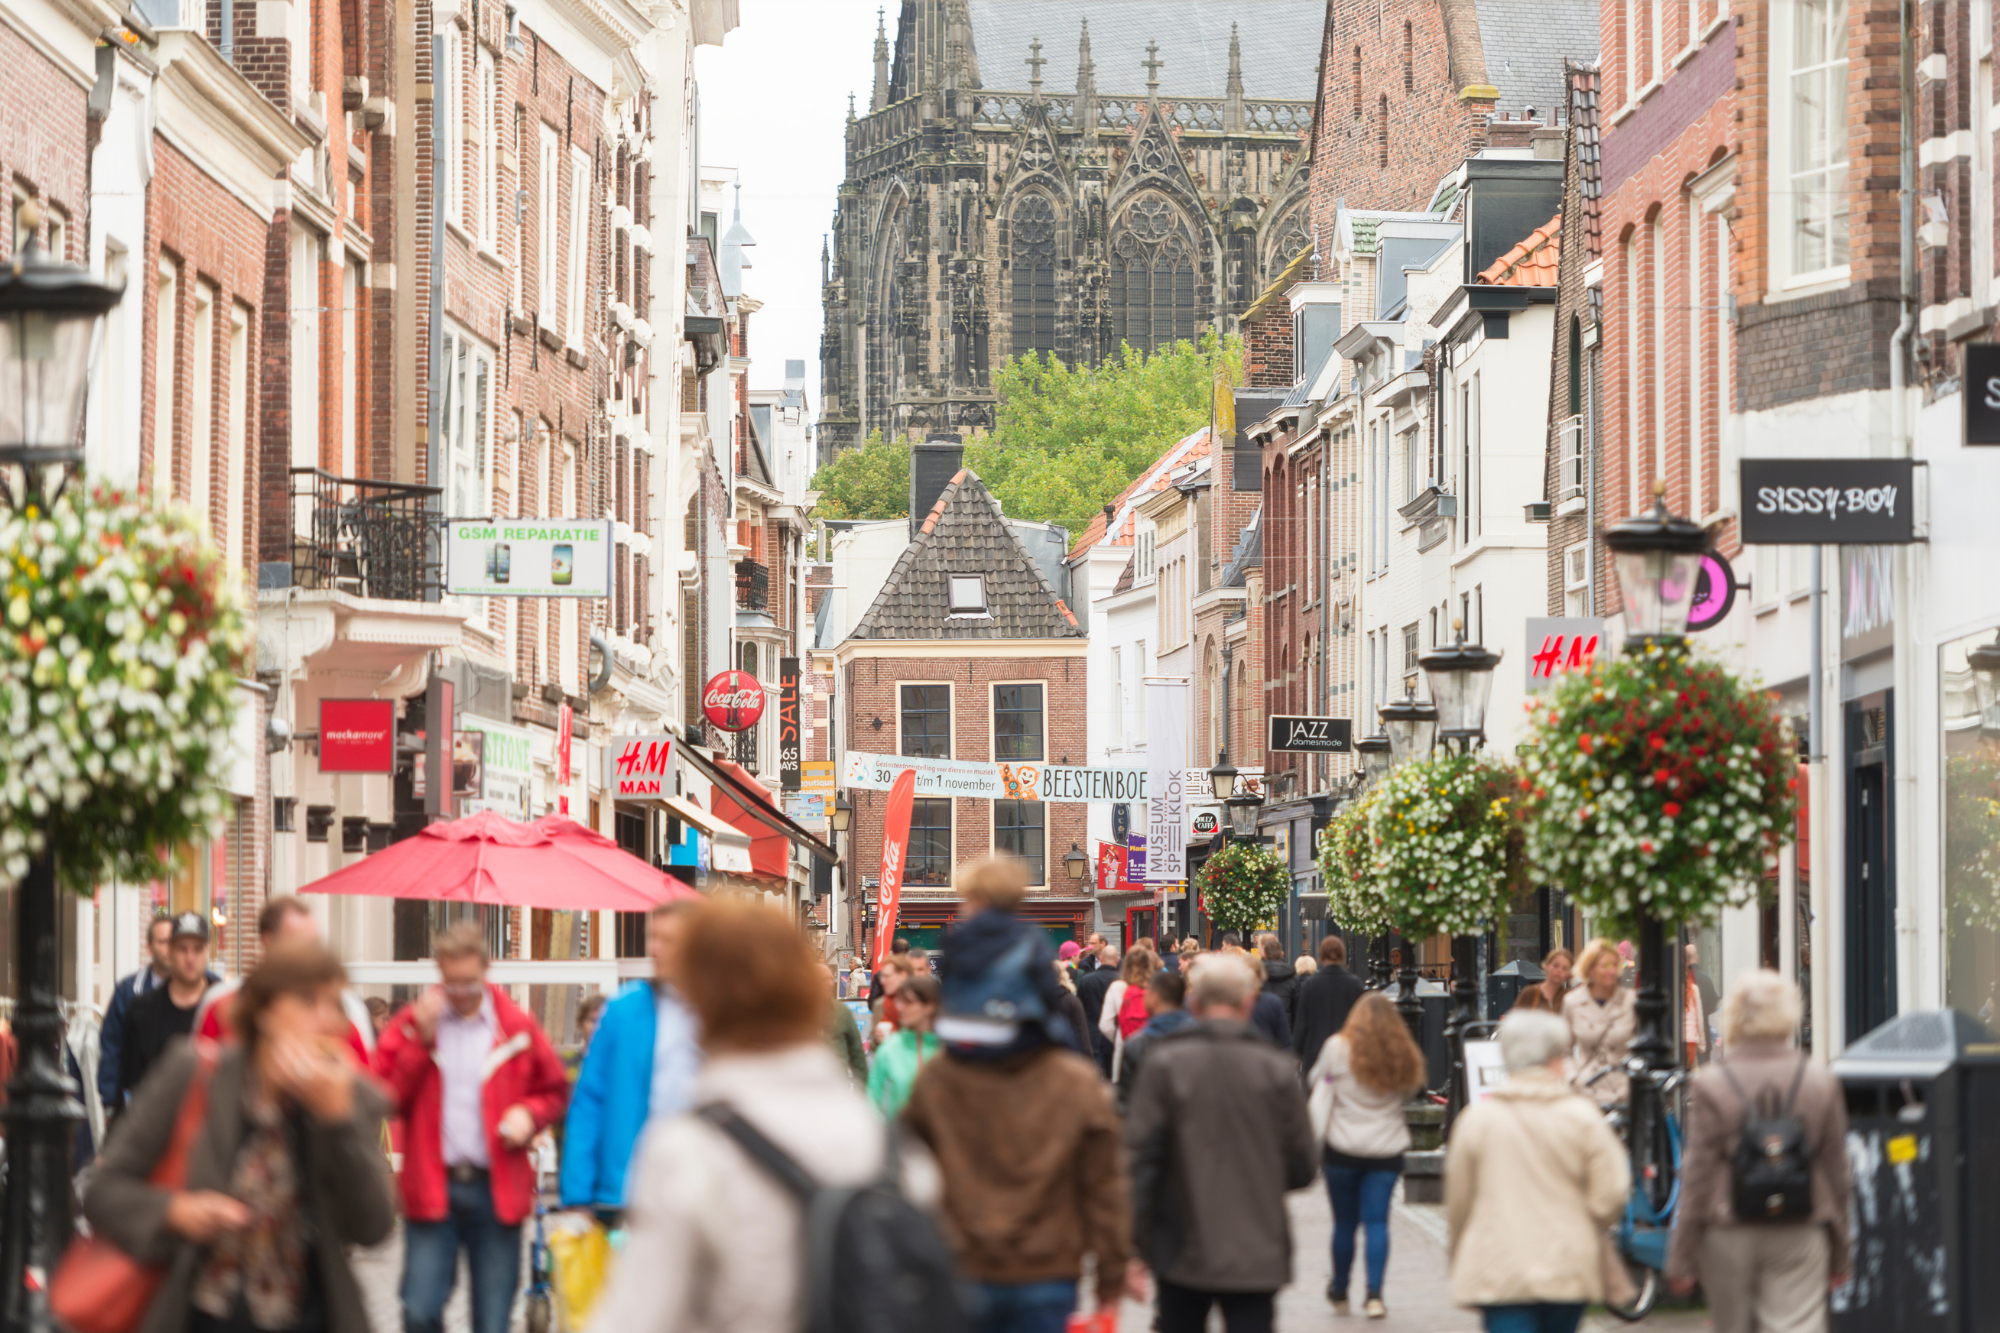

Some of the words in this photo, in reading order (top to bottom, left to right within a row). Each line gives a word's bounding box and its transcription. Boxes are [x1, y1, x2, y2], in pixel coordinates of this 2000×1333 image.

[1756, 484, 1898, 521] SISSY-BOY
[458, 527, 497, 540] GSM
[503, 528, 600, 541] REPARATIE
[780, 674, 797, 742] SALE
[1286, 721, 1328, 747] JAZZ
[1292, 738, 1342, 747] damesmode
[616, 740, 670, 776] H&M
[620, 780, 660, 794] MAN
[875, 770, 891, 783] 30
[917, 774, 933, 787] t/m
[936, 775, 942, 787] 1
[946, 779, 996, 791] november
[1150, 797, 1164, 872] MUSEUM
